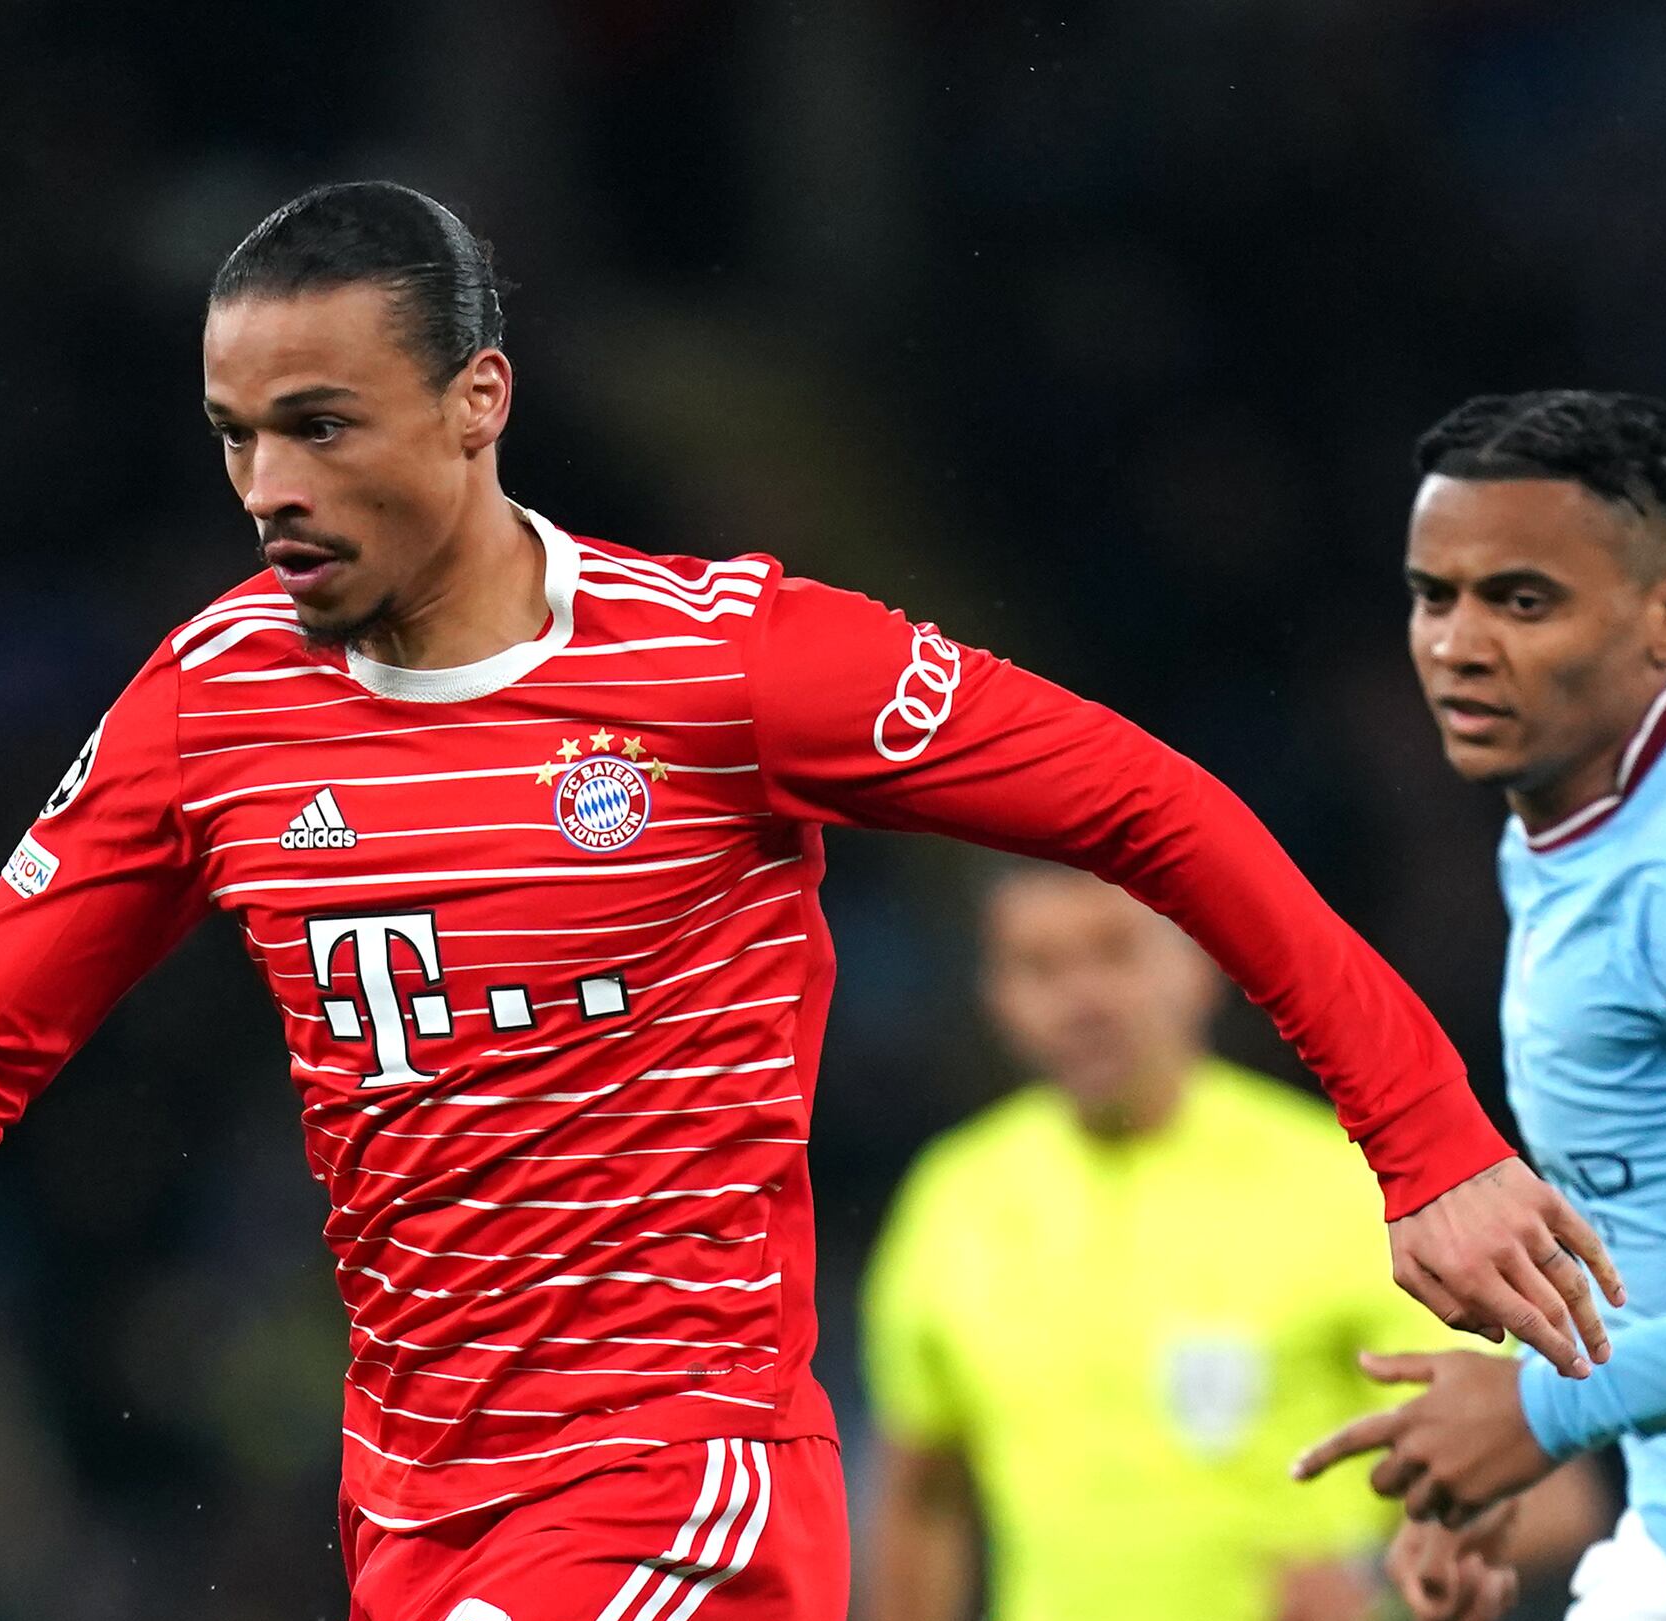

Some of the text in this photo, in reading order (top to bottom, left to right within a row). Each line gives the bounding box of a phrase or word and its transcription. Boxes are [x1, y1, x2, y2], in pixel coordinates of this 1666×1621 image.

[563, 762, 642, 800] FC BAYERN
[279, 826, 358, 850] adidas
